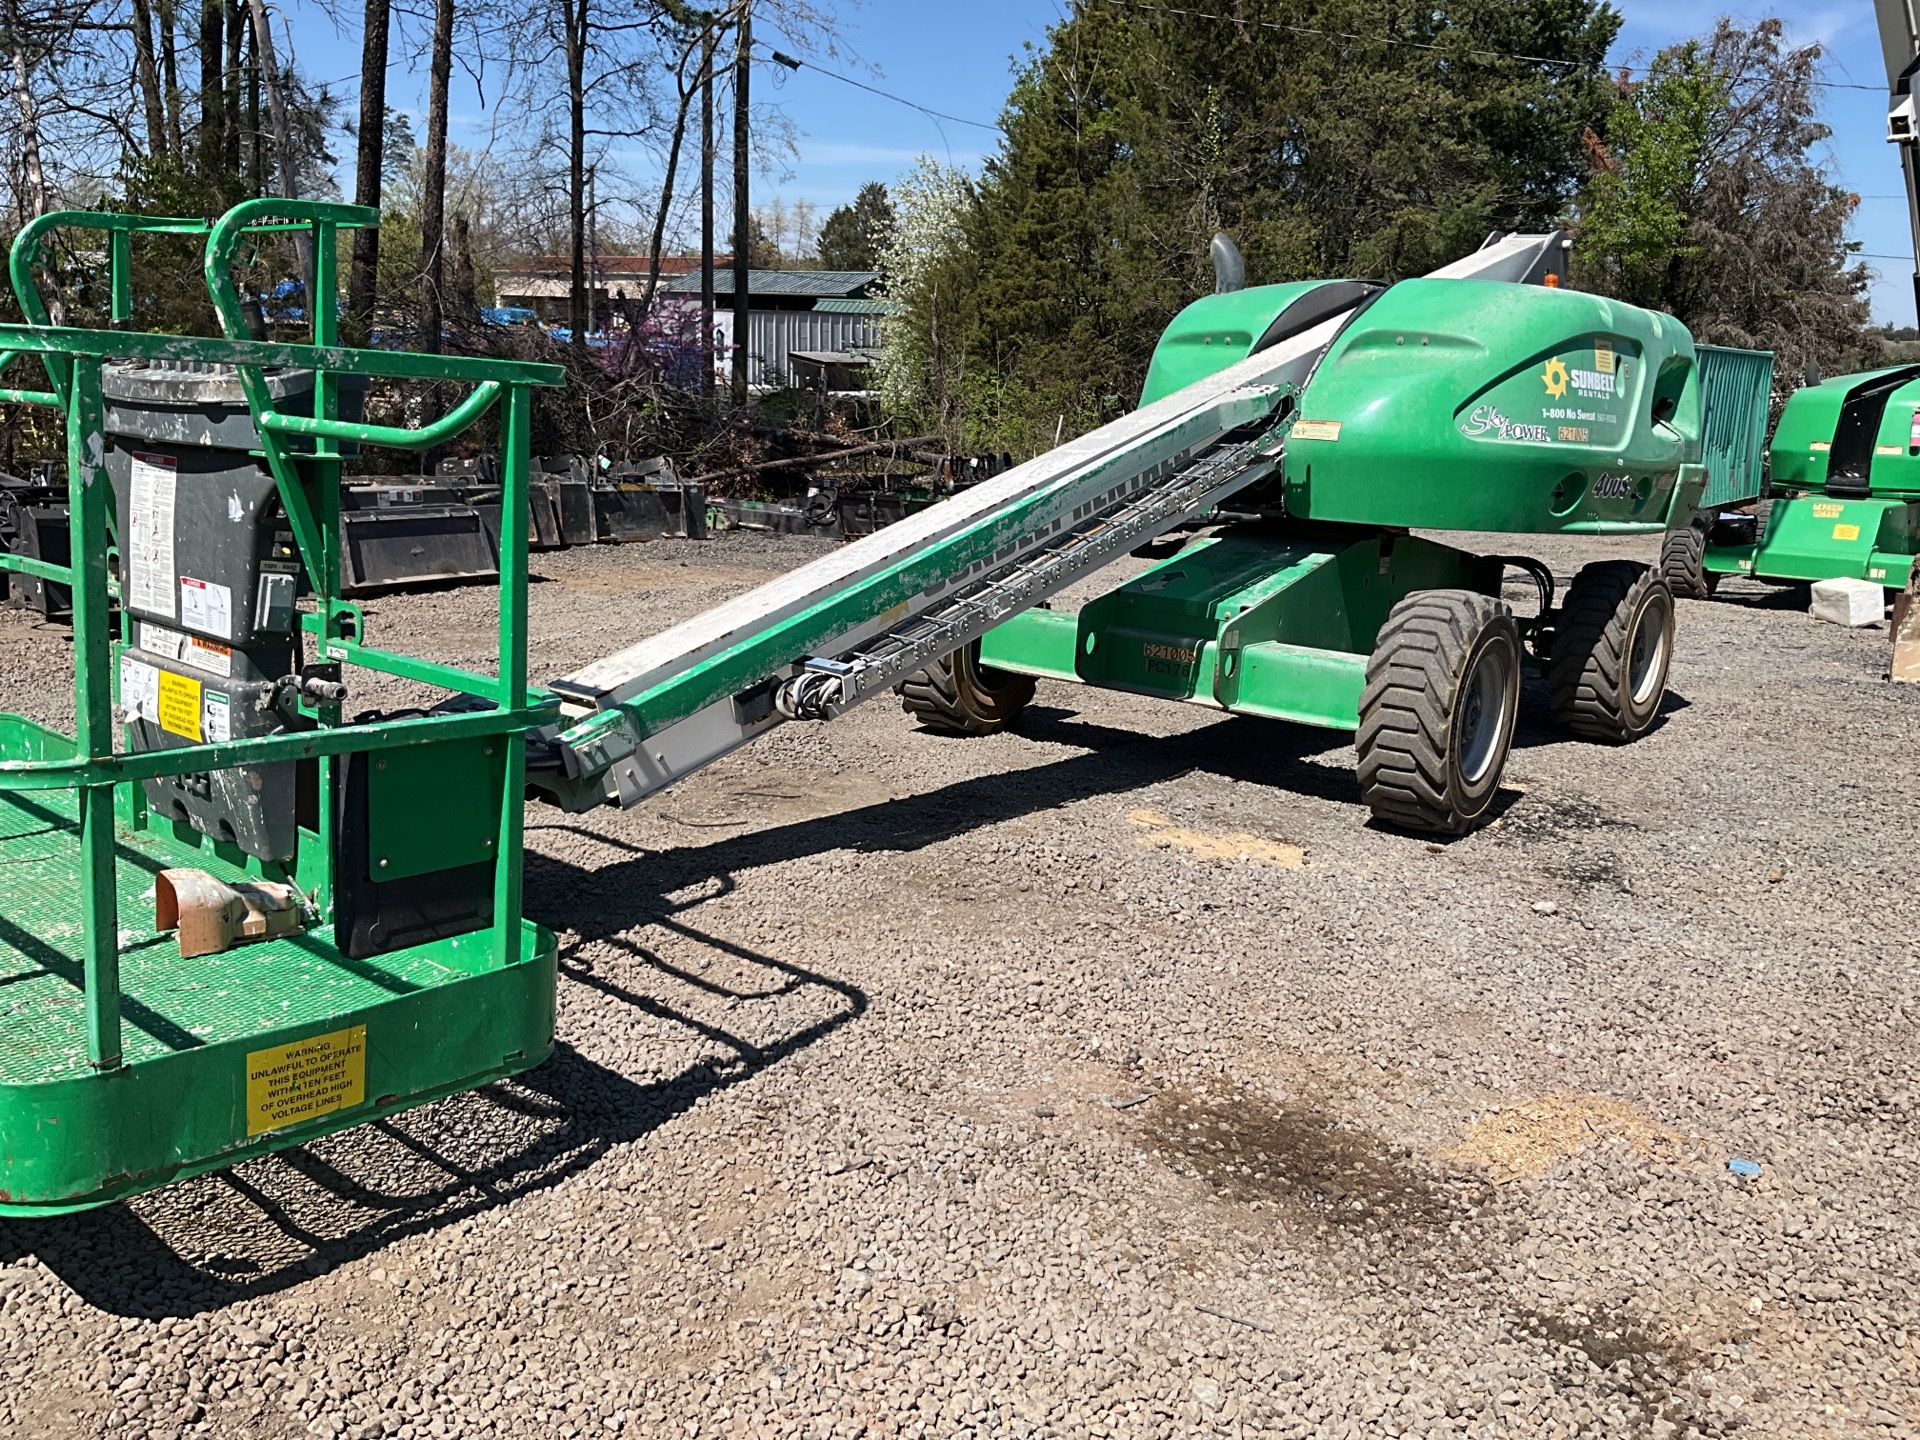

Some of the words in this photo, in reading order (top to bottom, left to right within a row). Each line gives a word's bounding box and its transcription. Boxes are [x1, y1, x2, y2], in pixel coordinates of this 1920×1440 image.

[1570, 369, 1615, 392] SUNBELT
[1578, 390, 1610, 400] RENTALS
[1462, 406, 1507, 439] Sky
[1542, 408, 1564, 418] 1-800
[1566, 408, 1576, 419] No
[1577, 410, 1595, 421] Sweat
[1504, 423, 1549, 441] POWER
[1559, 427, 1588, 441] 621005
[1144, 644, 1195, 662] 621005
[1148, 660, 1190, 676] PC176
[286, 1043, 330, 1059] WARNING
[251, 1060, 304, 1080] UNLAWFUL
[305, 1057, 317, 1066] TO
[320, 1045, 361, 1062] OPERATE
[268, 1075, 290, 1086] THIS
[293, 1060, 346, 1081] EQUIPMENT
[303, 1079, 321, 1089] TEN
[324, 1071, 346, 1083] FEET
[261, 1102, 274, 1112] OF
[277, 1088, 328, 1108] OVERHEAD
[331, 1080, 352, 1092] HIGH
[272, 1102, 313, 1120] VOLTAGE
[316, 1094, 342, 1108] LINES
